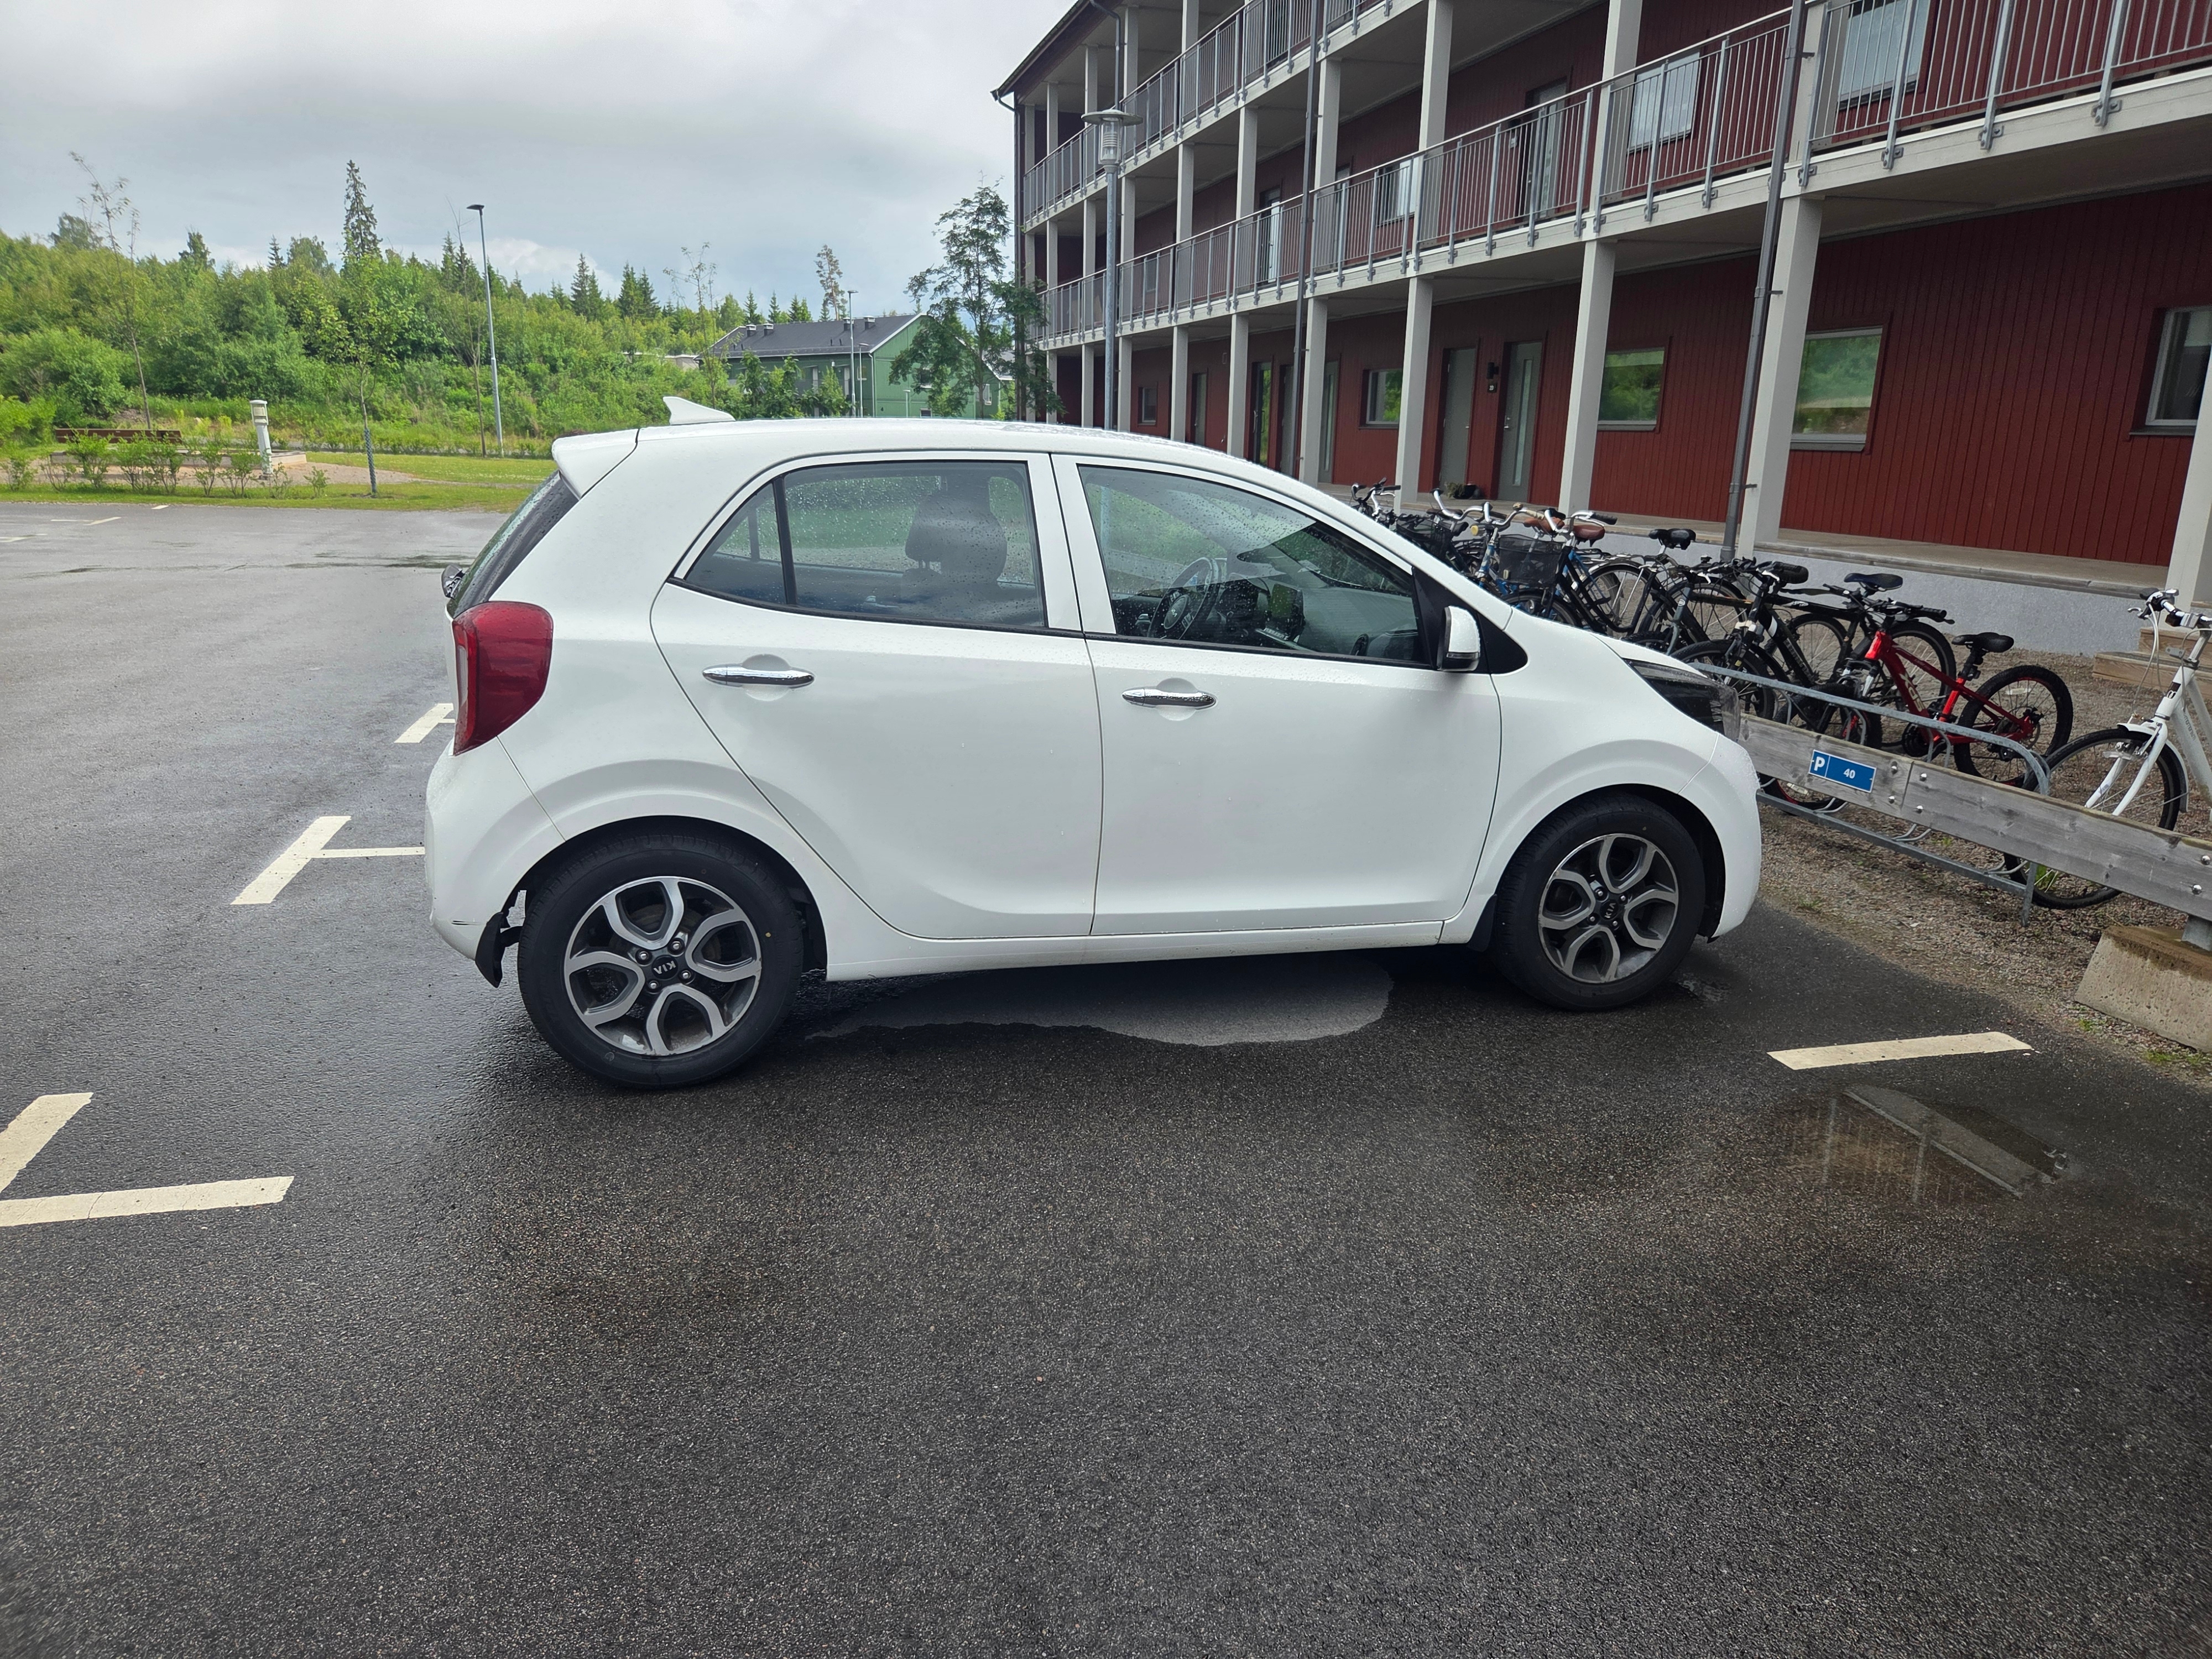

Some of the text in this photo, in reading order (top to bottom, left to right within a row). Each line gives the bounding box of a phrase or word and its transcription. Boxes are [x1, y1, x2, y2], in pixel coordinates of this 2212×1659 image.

[1814, 756, 1855, 779] P 40
[1604, 902, 1616, 918] KIA
[653, 960, 676, 974] KIA
